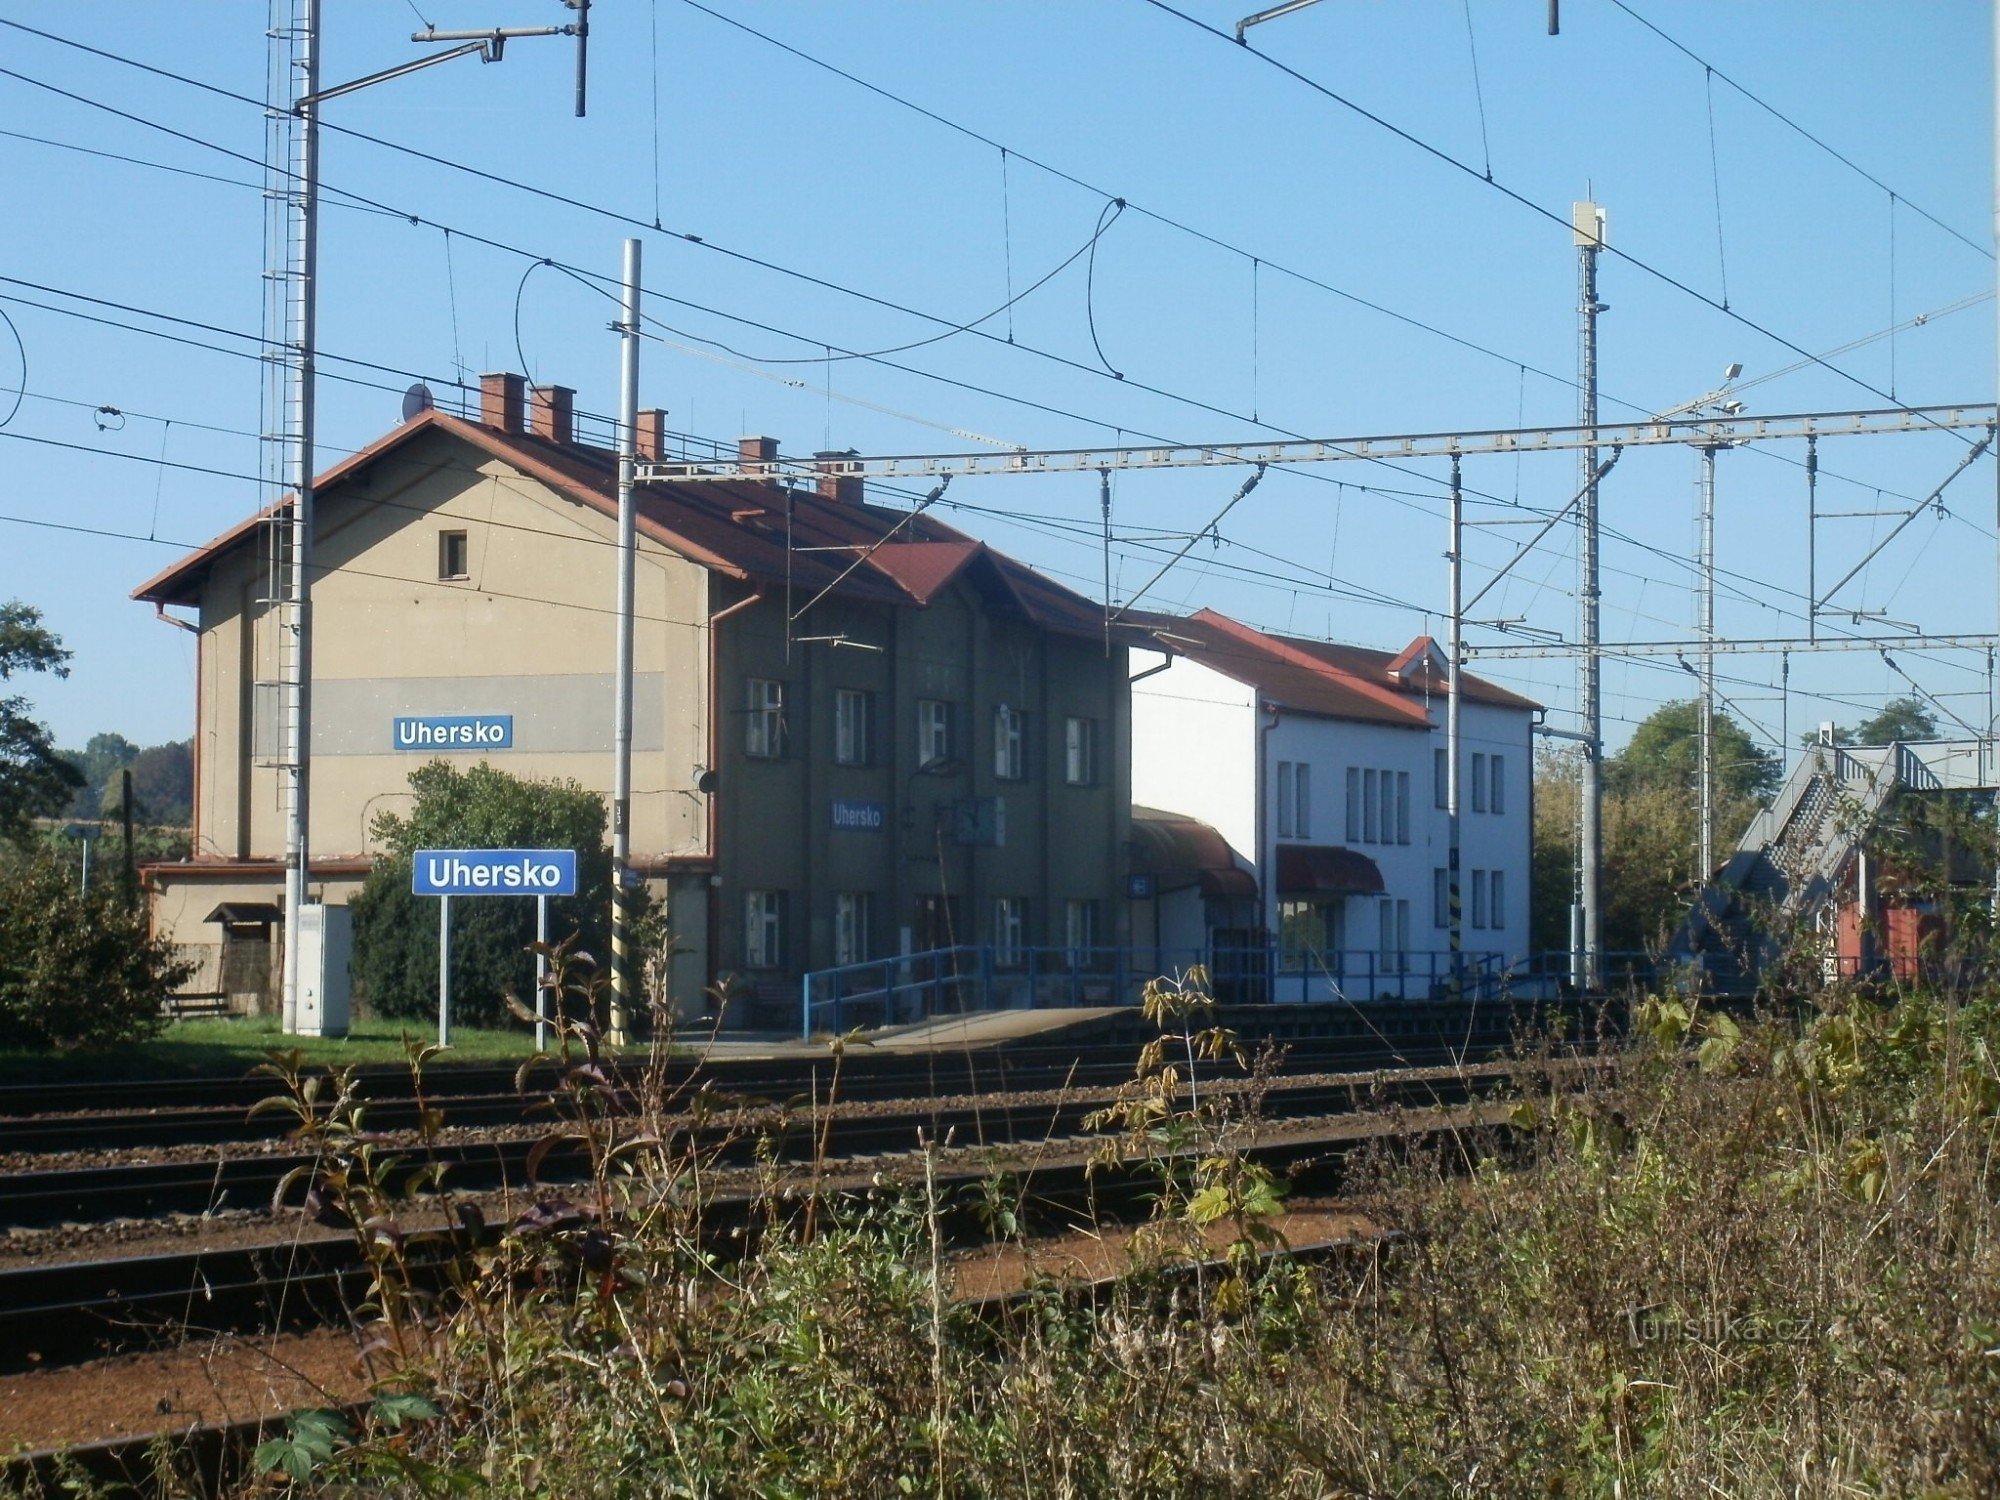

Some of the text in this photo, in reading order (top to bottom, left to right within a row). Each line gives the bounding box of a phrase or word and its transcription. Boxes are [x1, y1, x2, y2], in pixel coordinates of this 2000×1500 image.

[400, 721, 504, 744] Uhersko
[832, 803, 881, 827] Uhersko
[429, 858, 561, 888] Uhersko
